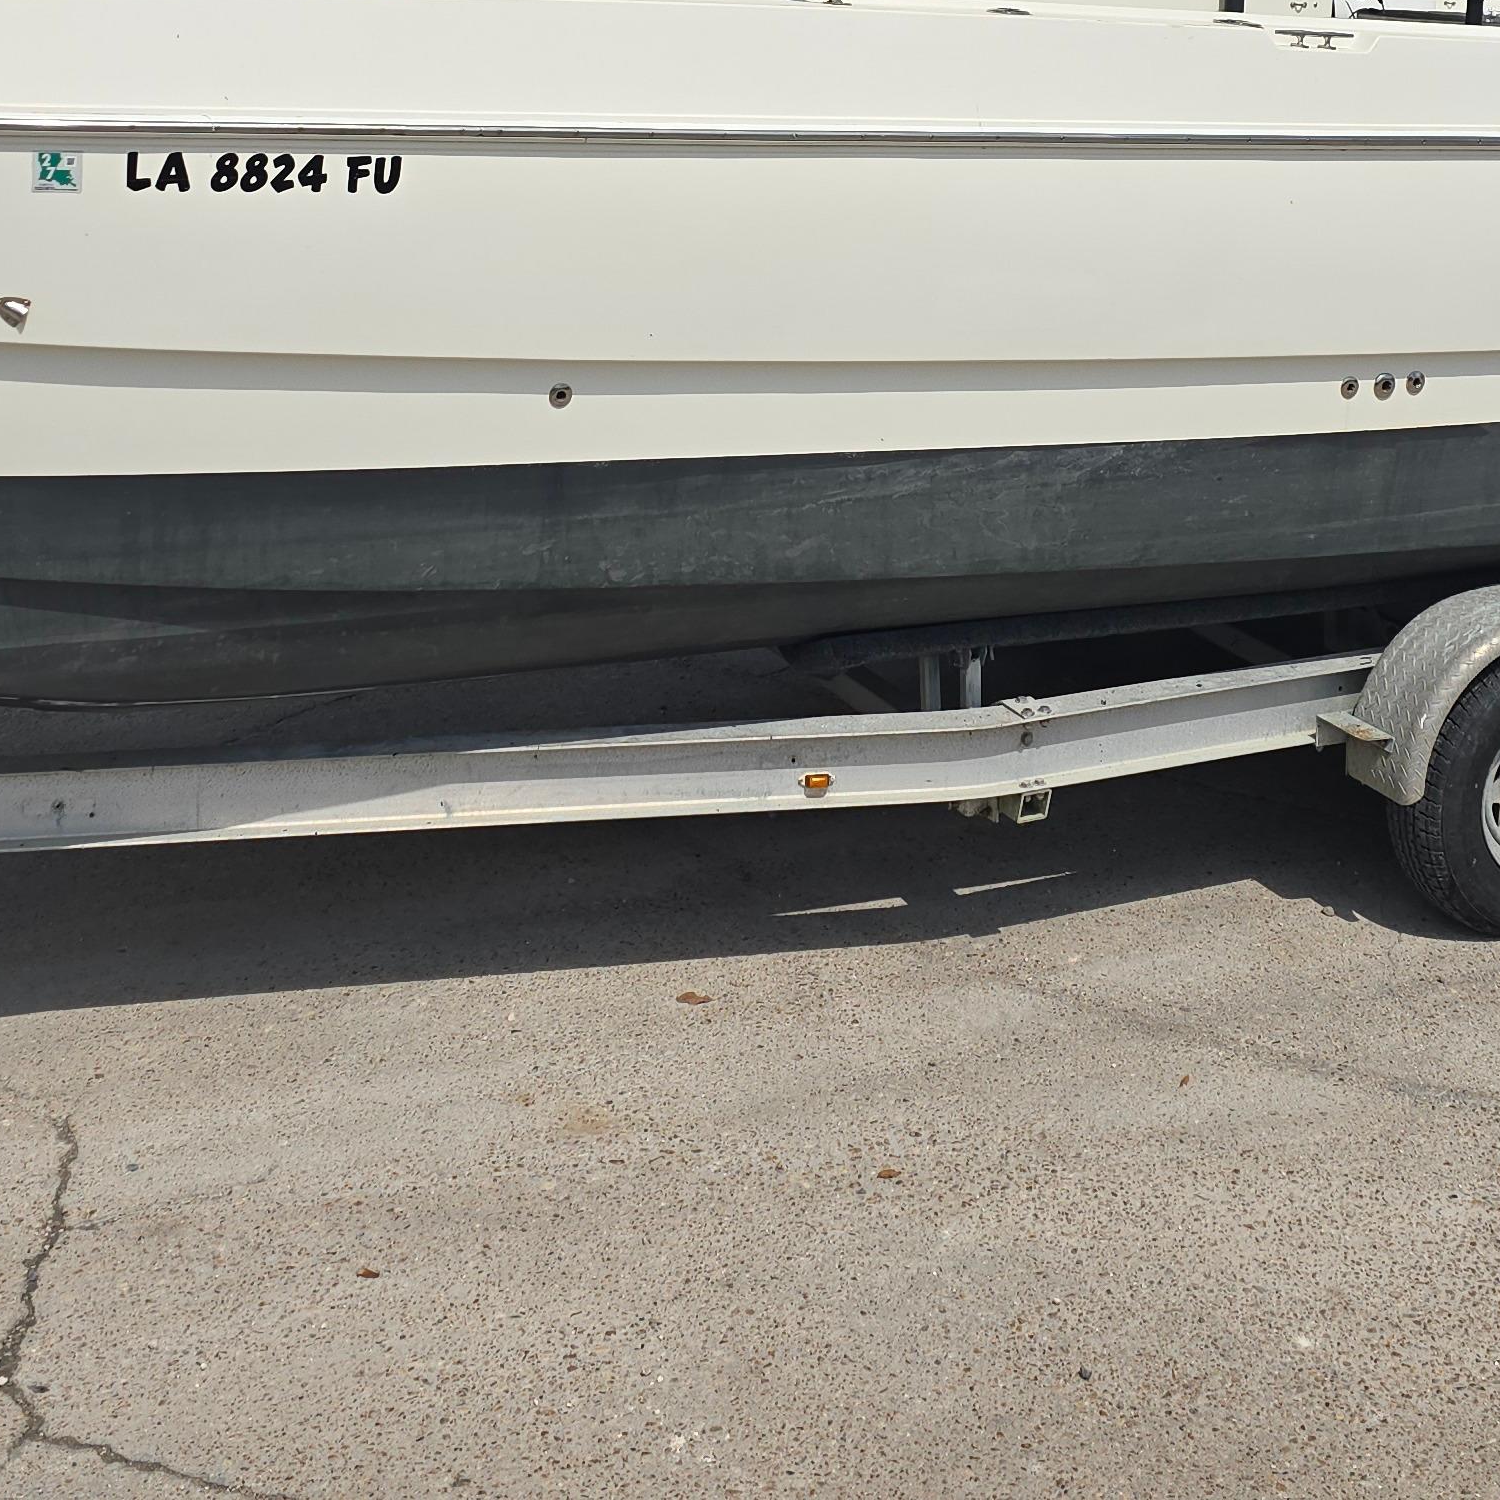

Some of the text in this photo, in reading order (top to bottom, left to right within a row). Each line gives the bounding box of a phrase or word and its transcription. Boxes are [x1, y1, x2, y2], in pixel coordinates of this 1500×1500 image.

[126, 151, 403, 195] LA 8824 FU
